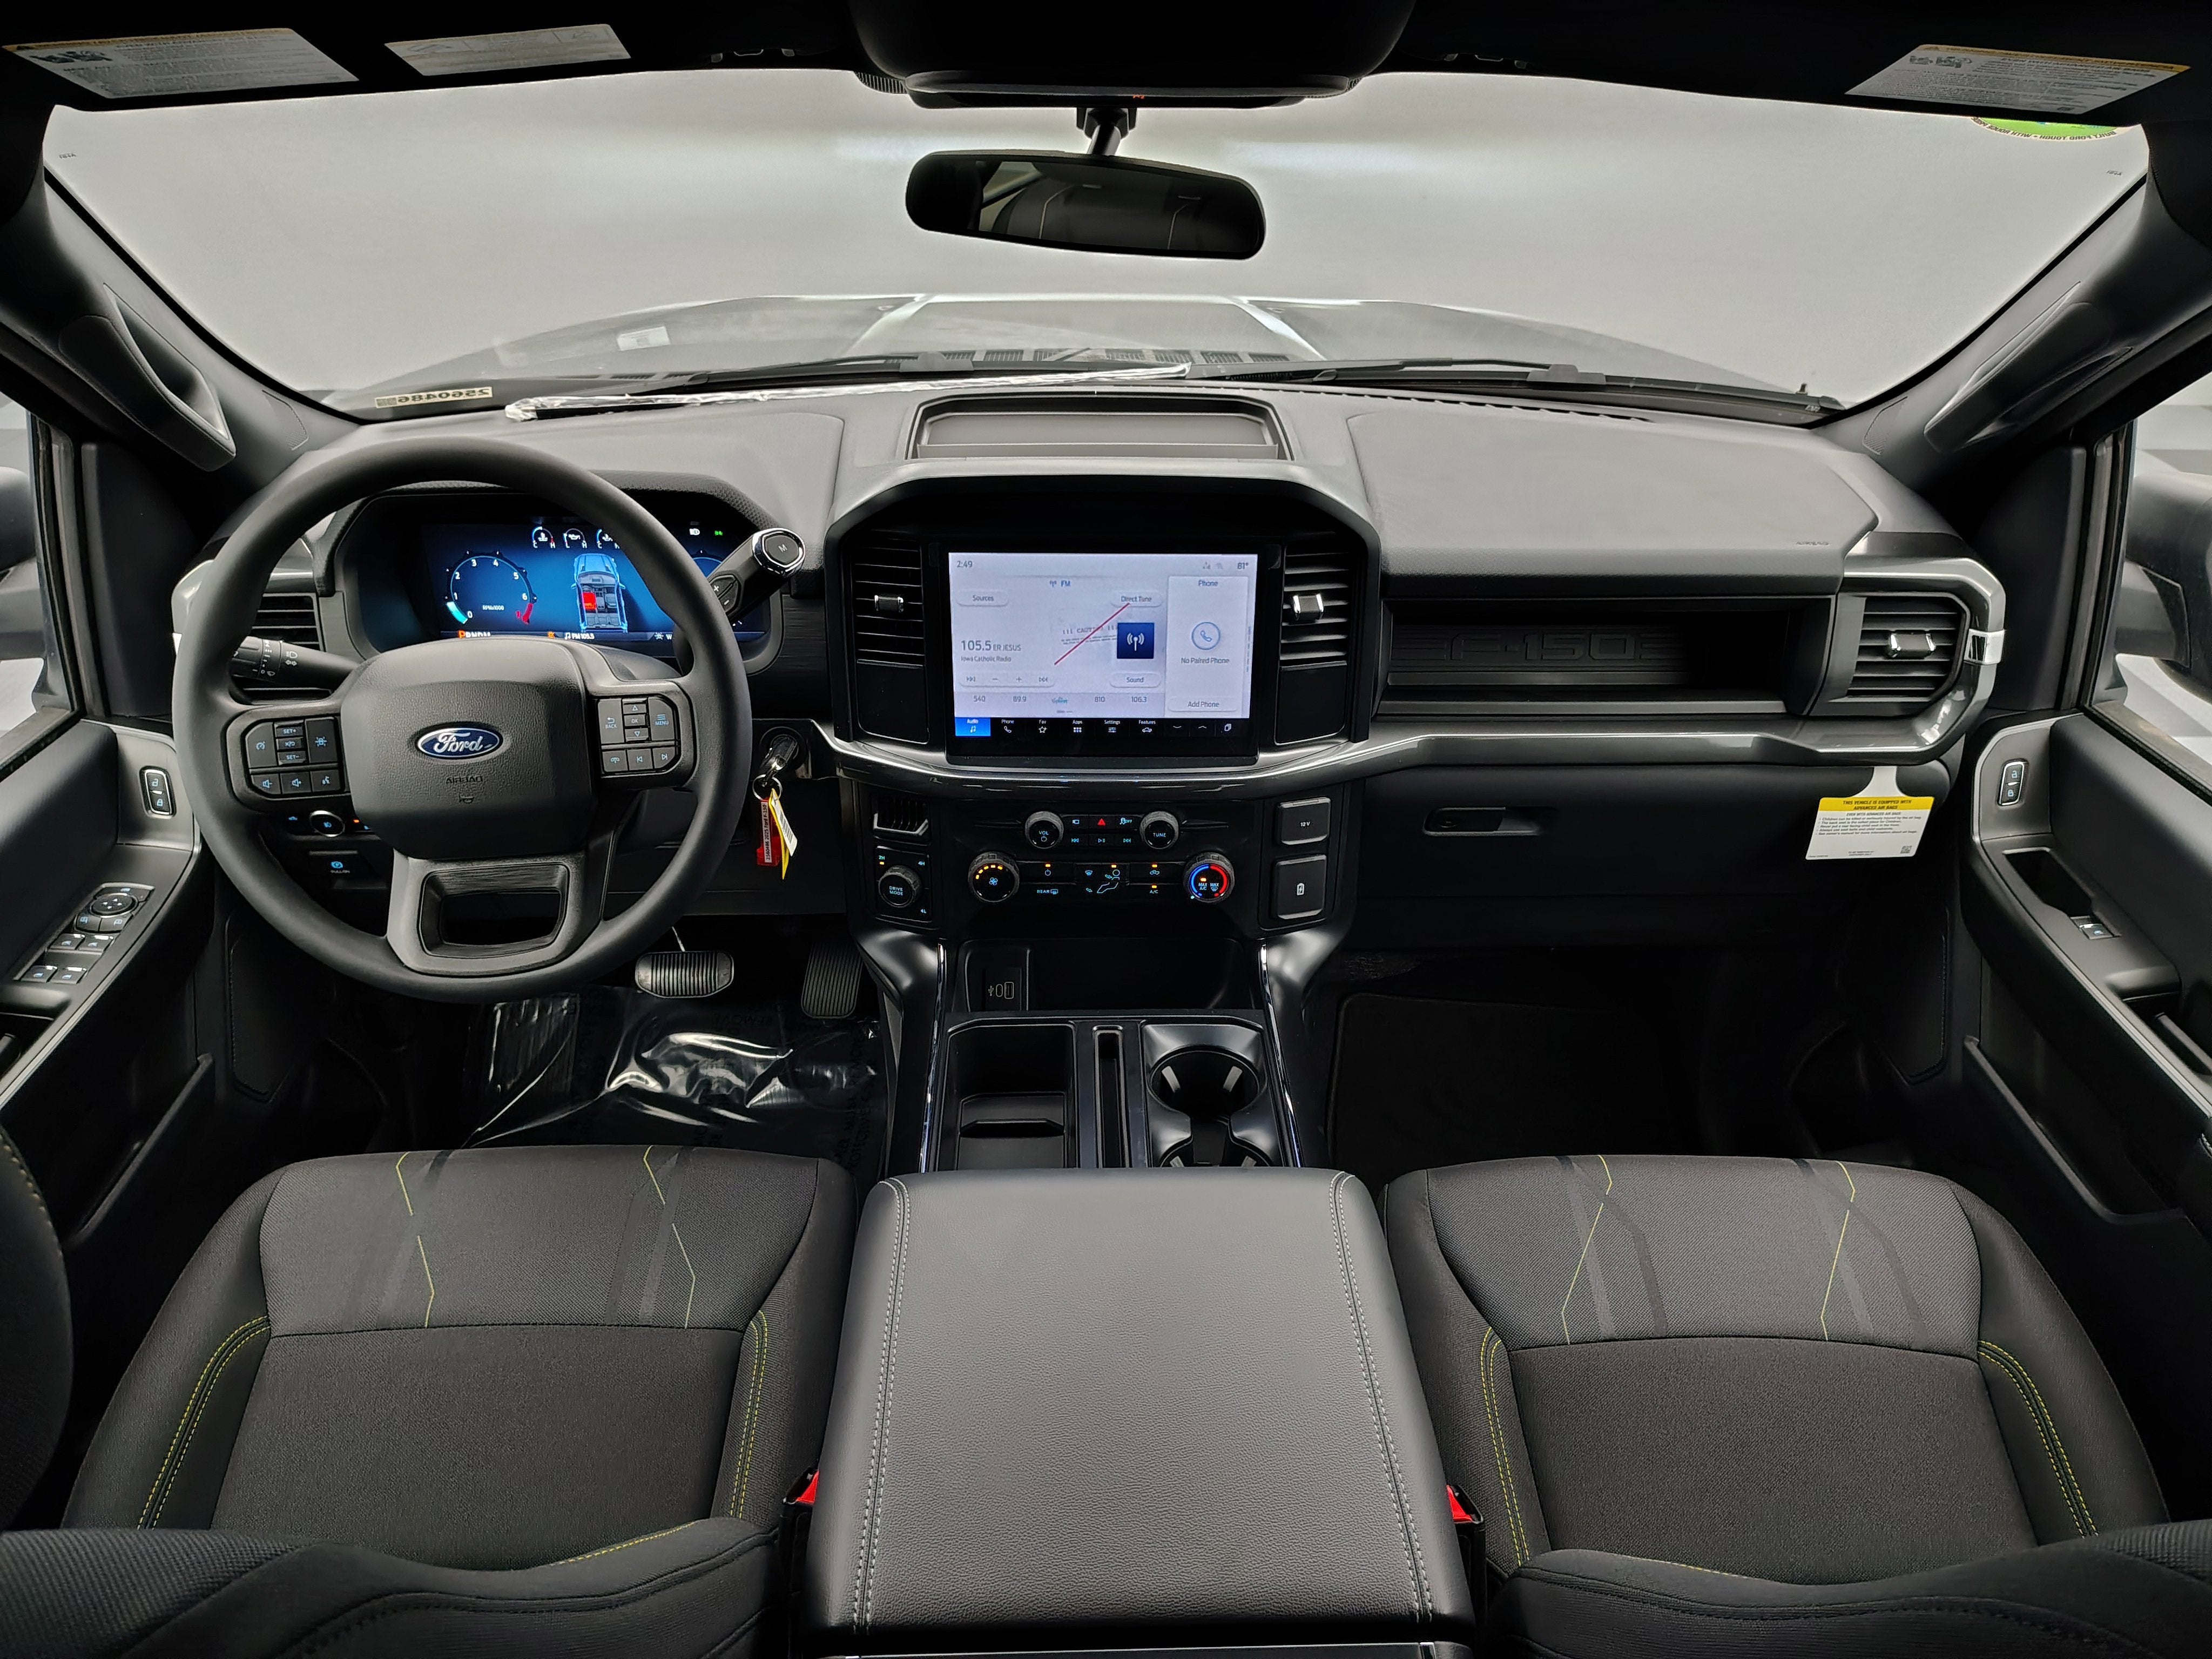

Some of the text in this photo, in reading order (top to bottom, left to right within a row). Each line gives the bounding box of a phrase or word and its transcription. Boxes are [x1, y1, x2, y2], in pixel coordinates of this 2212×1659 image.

[778, 544, 788, 552] M
[454, 592, 458, 600] 1
[961, 640, 992, 651] 105.5
[434, 732, 483, 753] Ford
